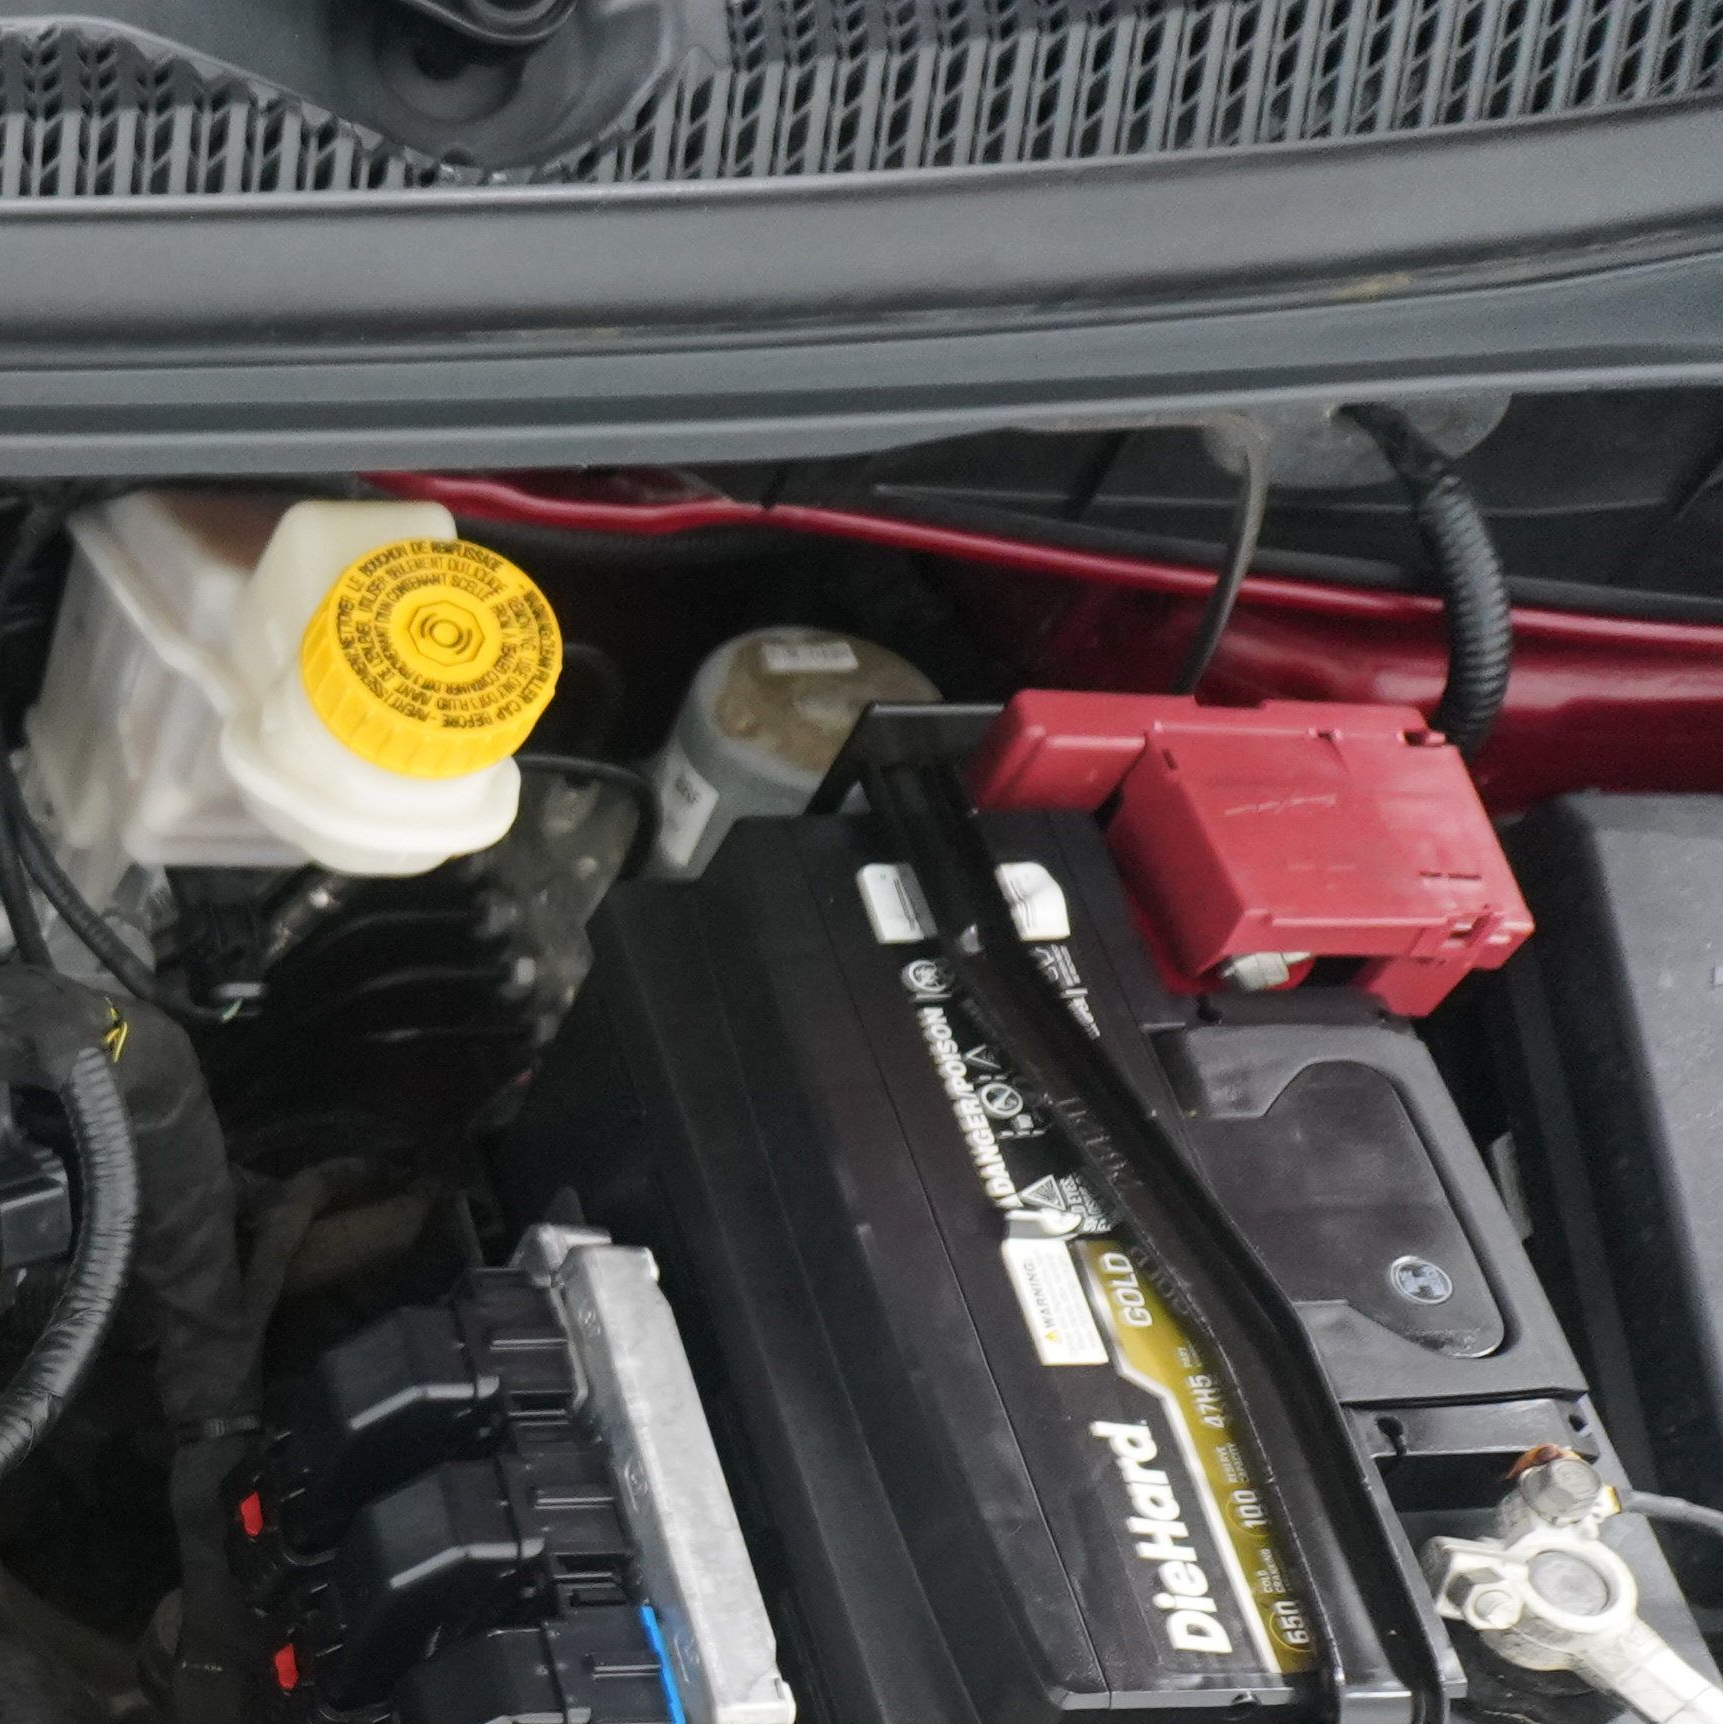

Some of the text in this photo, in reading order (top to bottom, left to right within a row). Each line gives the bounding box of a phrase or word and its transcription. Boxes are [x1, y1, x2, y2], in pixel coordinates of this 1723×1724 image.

[496, 700, 521, 720] CAP
[1101, 1252, 1153, 1327] GOLD
[1188, 1373, 1225, 1429] 47H5
[1089, 1420, 1233, 1653] DieHard
[1233, 1489, 1269, 1529] 100
